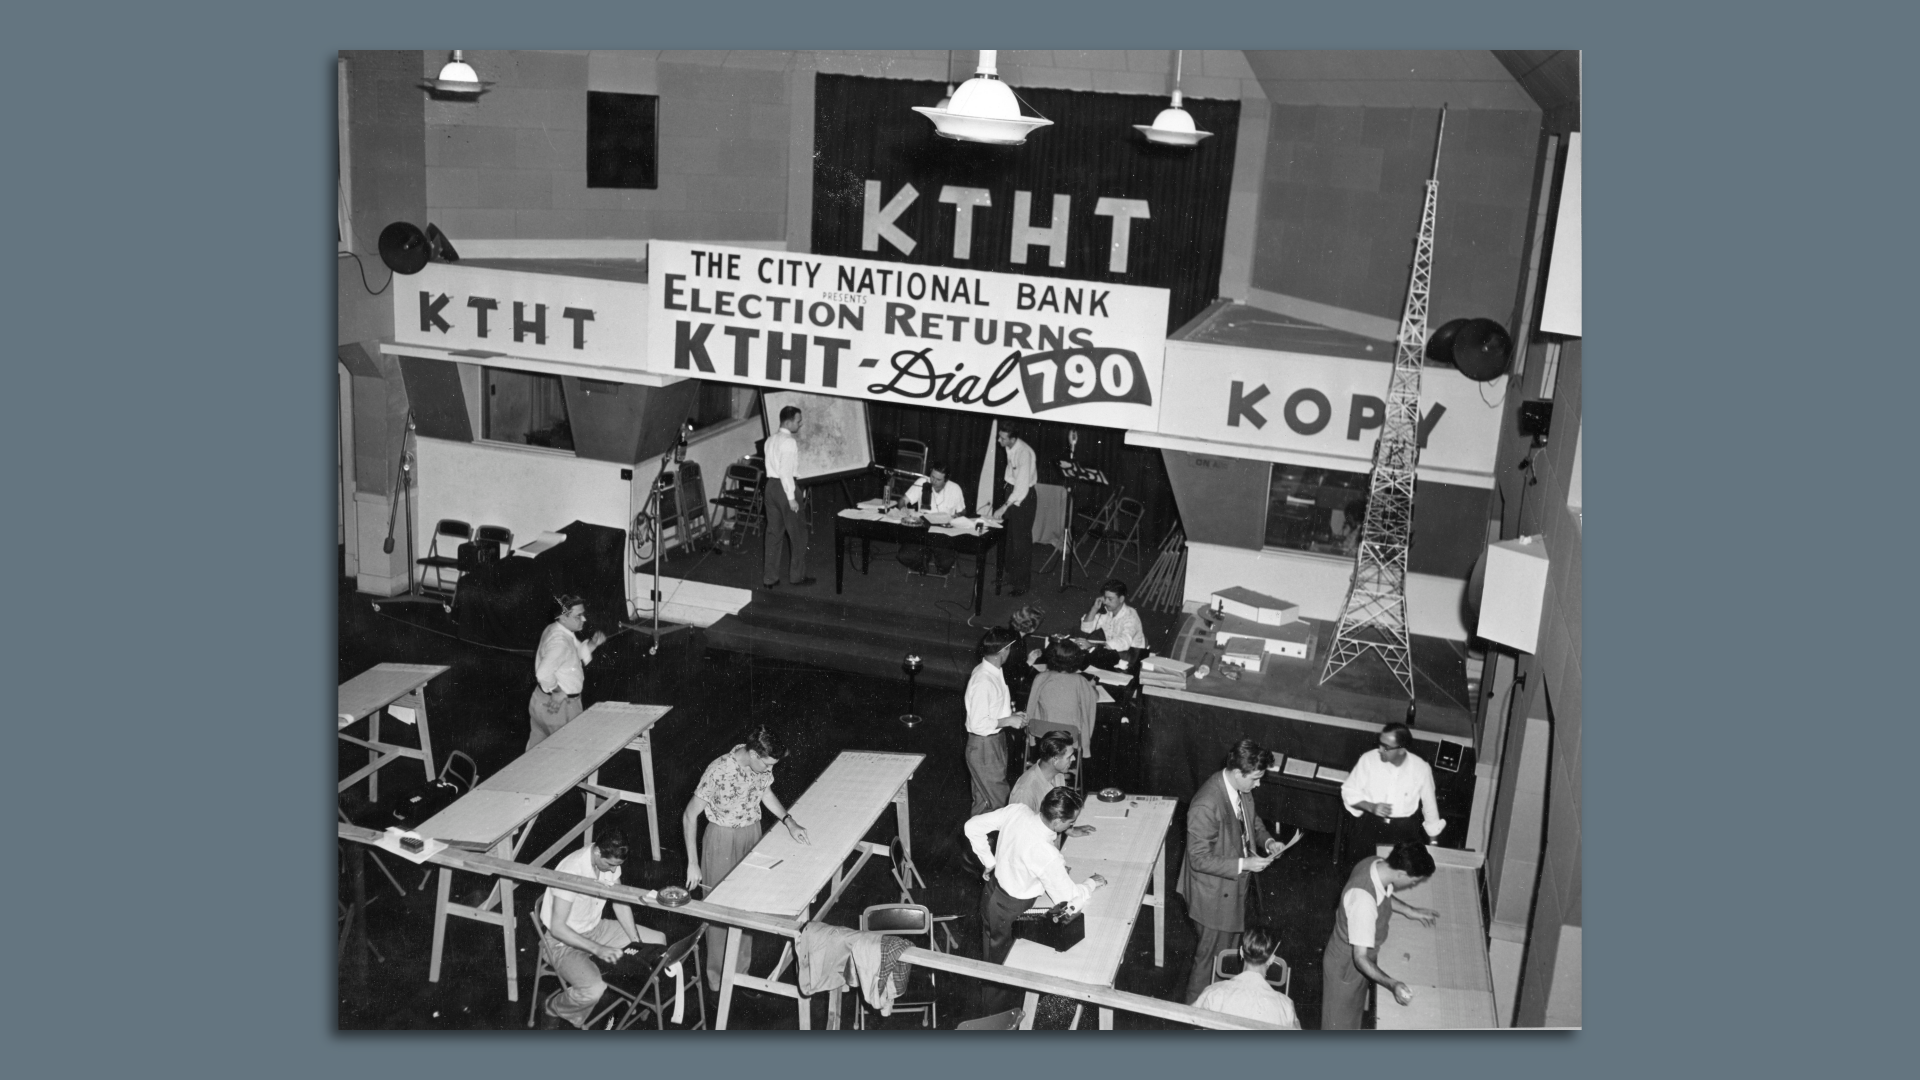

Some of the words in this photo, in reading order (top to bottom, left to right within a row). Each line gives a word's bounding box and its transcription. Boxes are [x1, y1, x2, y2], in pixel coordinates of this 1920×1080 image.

[862, 179, 1151, 273] KTHT
[663, 273, 864, 332] ELECTION
[884, 301, 1095, 350] RETURNS
[690, 249, 741, 281] THE
[757, 257, 822, 289] CITY
[837, 264, 990, 307] NATIONAL
[1016, 282, 1110, 318] BANK
[822, 291, 868, 305] PRESENTS
[419, 290, 596, 350] KTHT
[1026, 353, 1134, 404] 790
